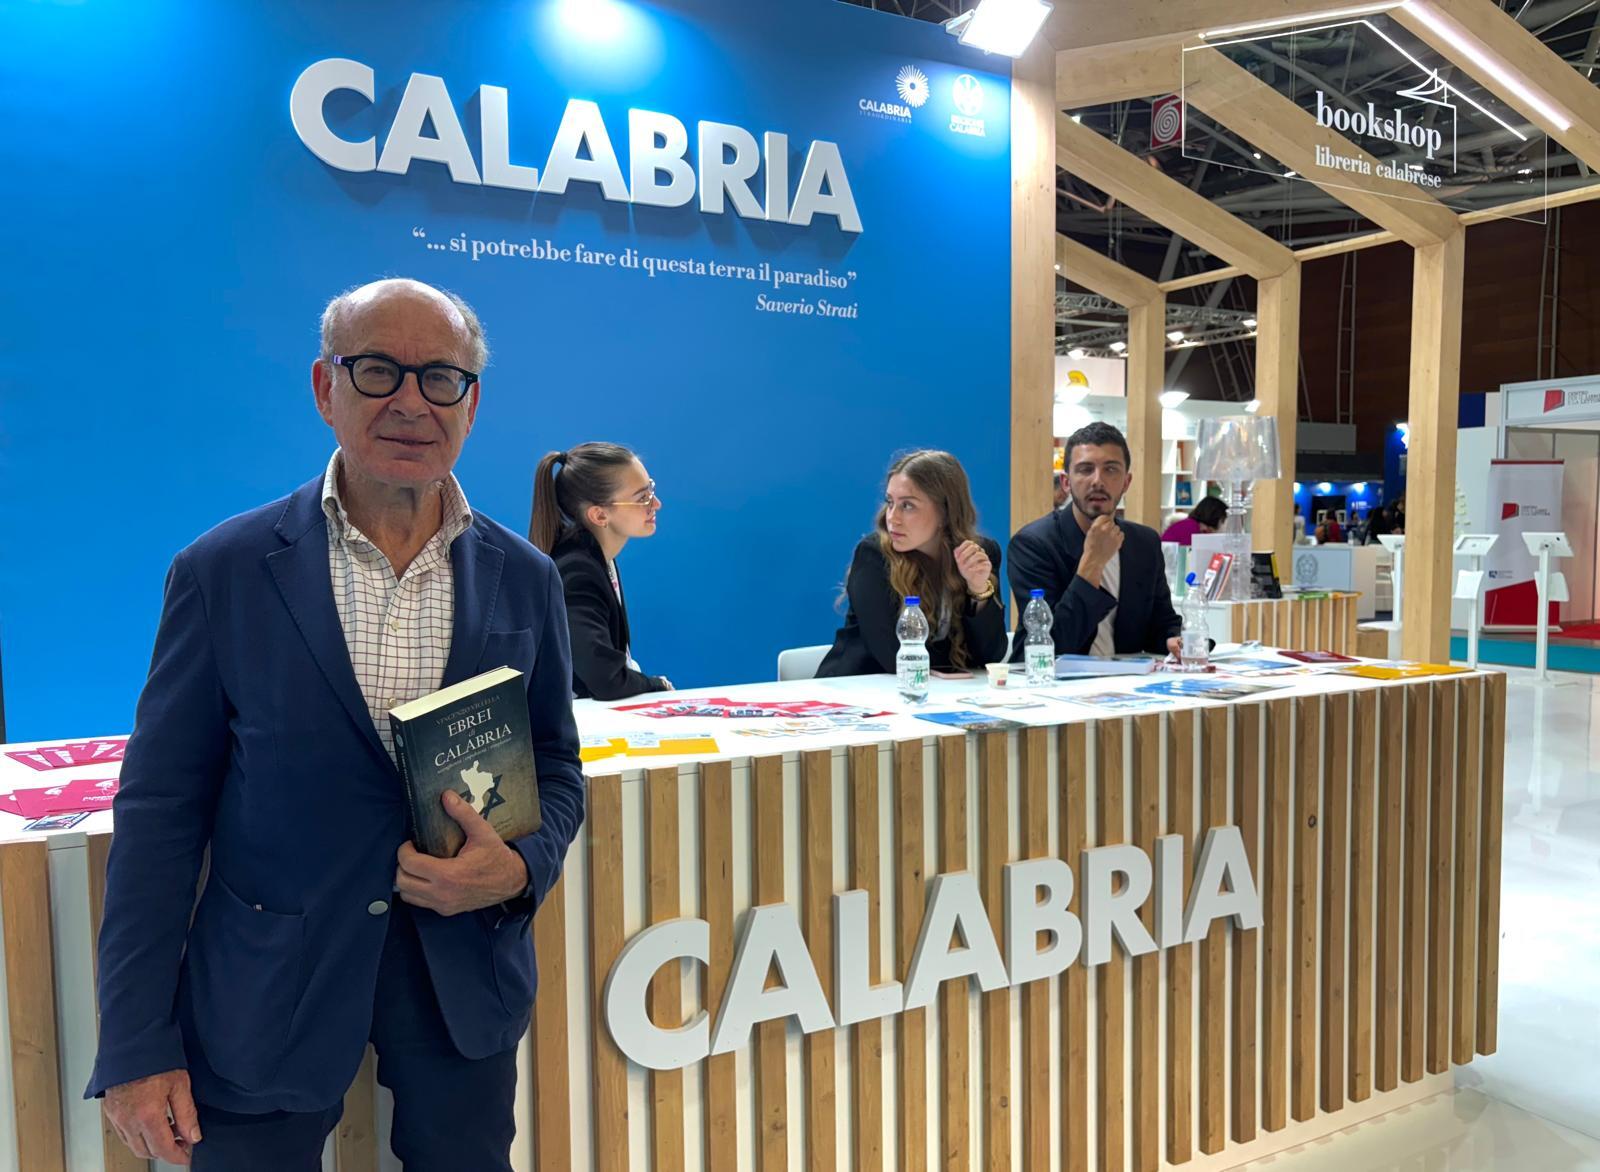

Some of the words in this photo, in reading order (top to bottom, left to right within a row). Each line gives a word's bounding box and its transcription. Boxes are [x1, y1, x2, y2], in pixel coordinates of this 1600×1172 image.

[859, 98, 911, 119] CALABRIA
[1315, 90, 1442, 160] bookshop
[289, 57, 864, 233] CALABRIA
[1315, 144, 1371, 175] libreria
[1375, 160, 1442, 188] calabrese
[450, 232, 468, 253] si
[471, 238, 571, 261] potrebbe
[575, 243, 616, 266] fare
[619, 247, 640, 269] di
[642, 255, 706, 277] questa
[708, 259, 756, 280] terra
[758, 263, 771, 281] il
[773, 268, 857, 289] paradiso”
[755, 293, 814, 316] Saverio
[816, 299, 859, 319] Strati
[447, 707, 492, 737] EBREI
[434, 723, 513, 767] CALABRIA
[604, 825, 1264, 1071] CALABRIA
